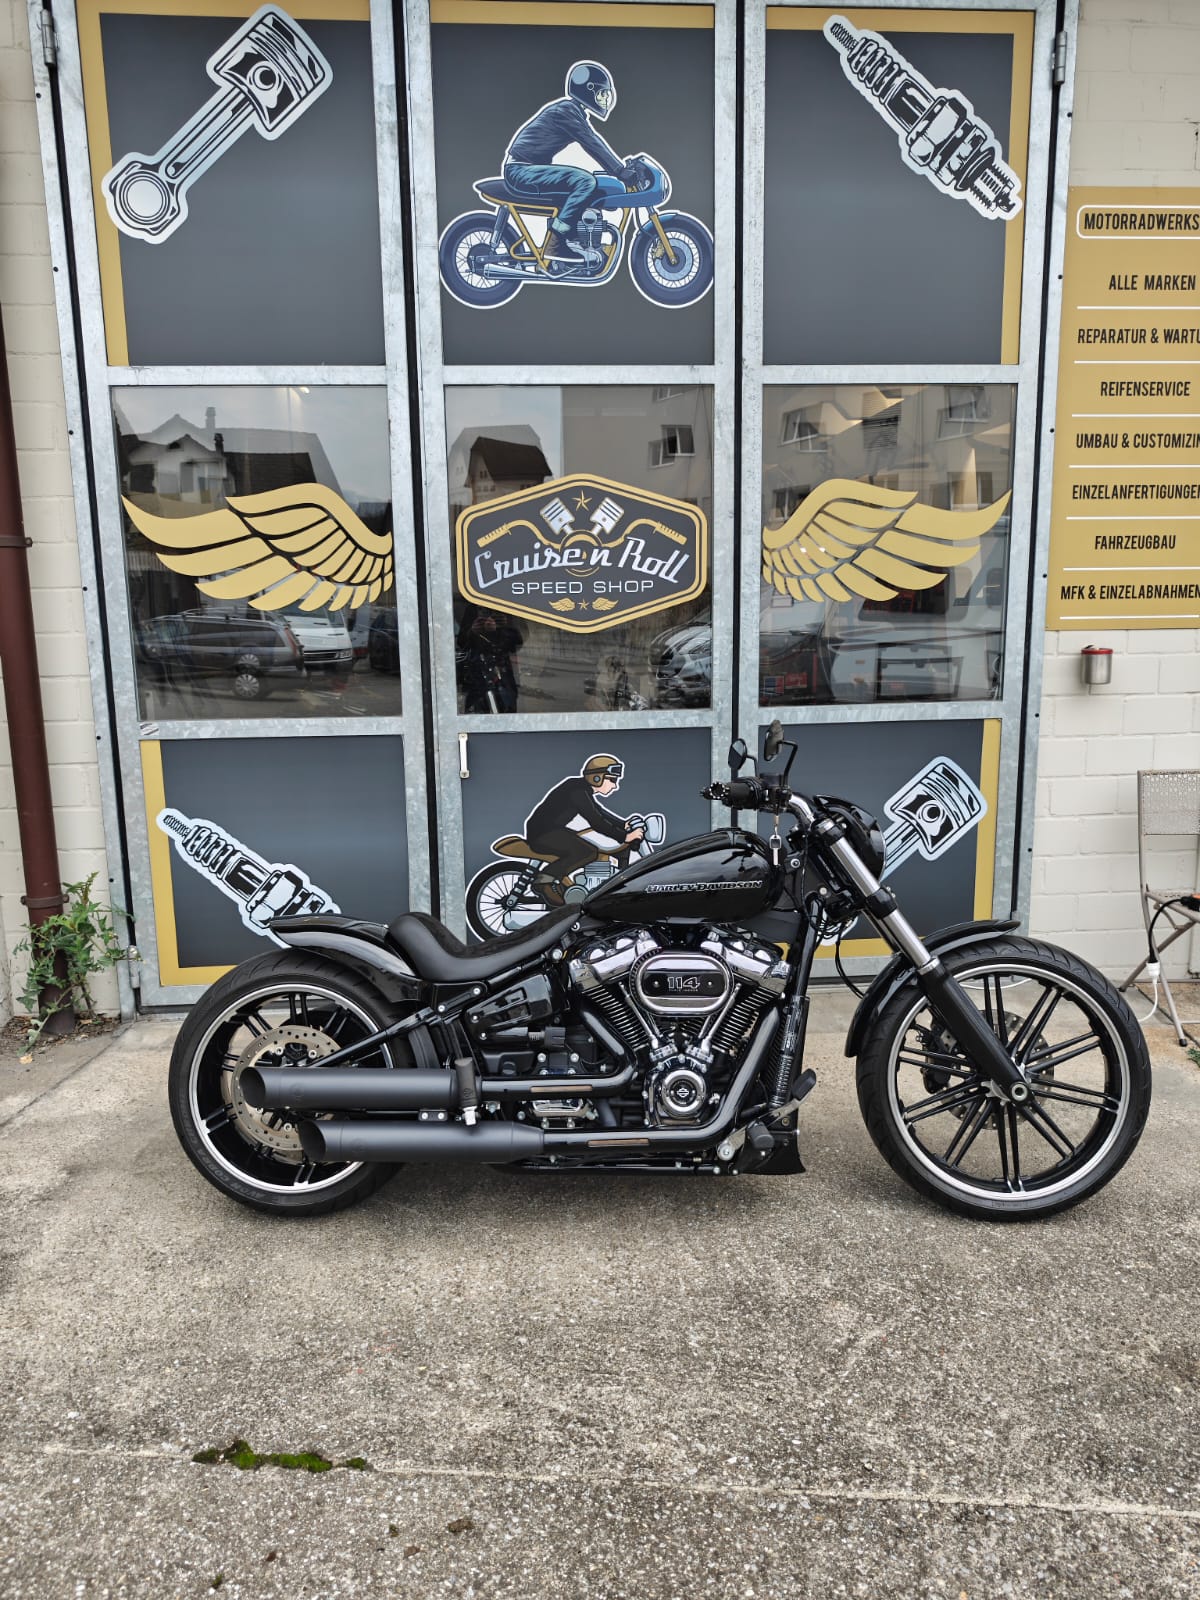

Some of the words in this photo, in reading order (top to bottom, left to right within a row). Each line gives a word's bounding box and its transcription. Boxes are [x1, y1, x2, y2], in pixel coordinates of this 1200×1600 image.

[1084, 213, 1200, 230] MOTORRADWERKS
[1109, 275, 1138, 290] ALLE
[1144, 275, 1196, 290] MARKEN
[1078, 329, 1147, 344] REPARATUR
[1150, 328, 1159, 344] &
[1100, 381, 1191, 397] REIFENSERVICE
[1076, 433, 1118, 448] UMBAU
[1121, 433, 1130, 448] &
[1095, 535, 1176, 550] FAHRZEUGBAU
[474, 542, 584, 589] Cruise
[618, 536, 690, 583] Roll
[512, 582, 583, 595] SPEED
[593, 580, 654, 593] SHOP
[1061, 585, 1085, 600] MFK
[1088, 585, 1096, 600] &
[667, 976, 700, 989] 114
